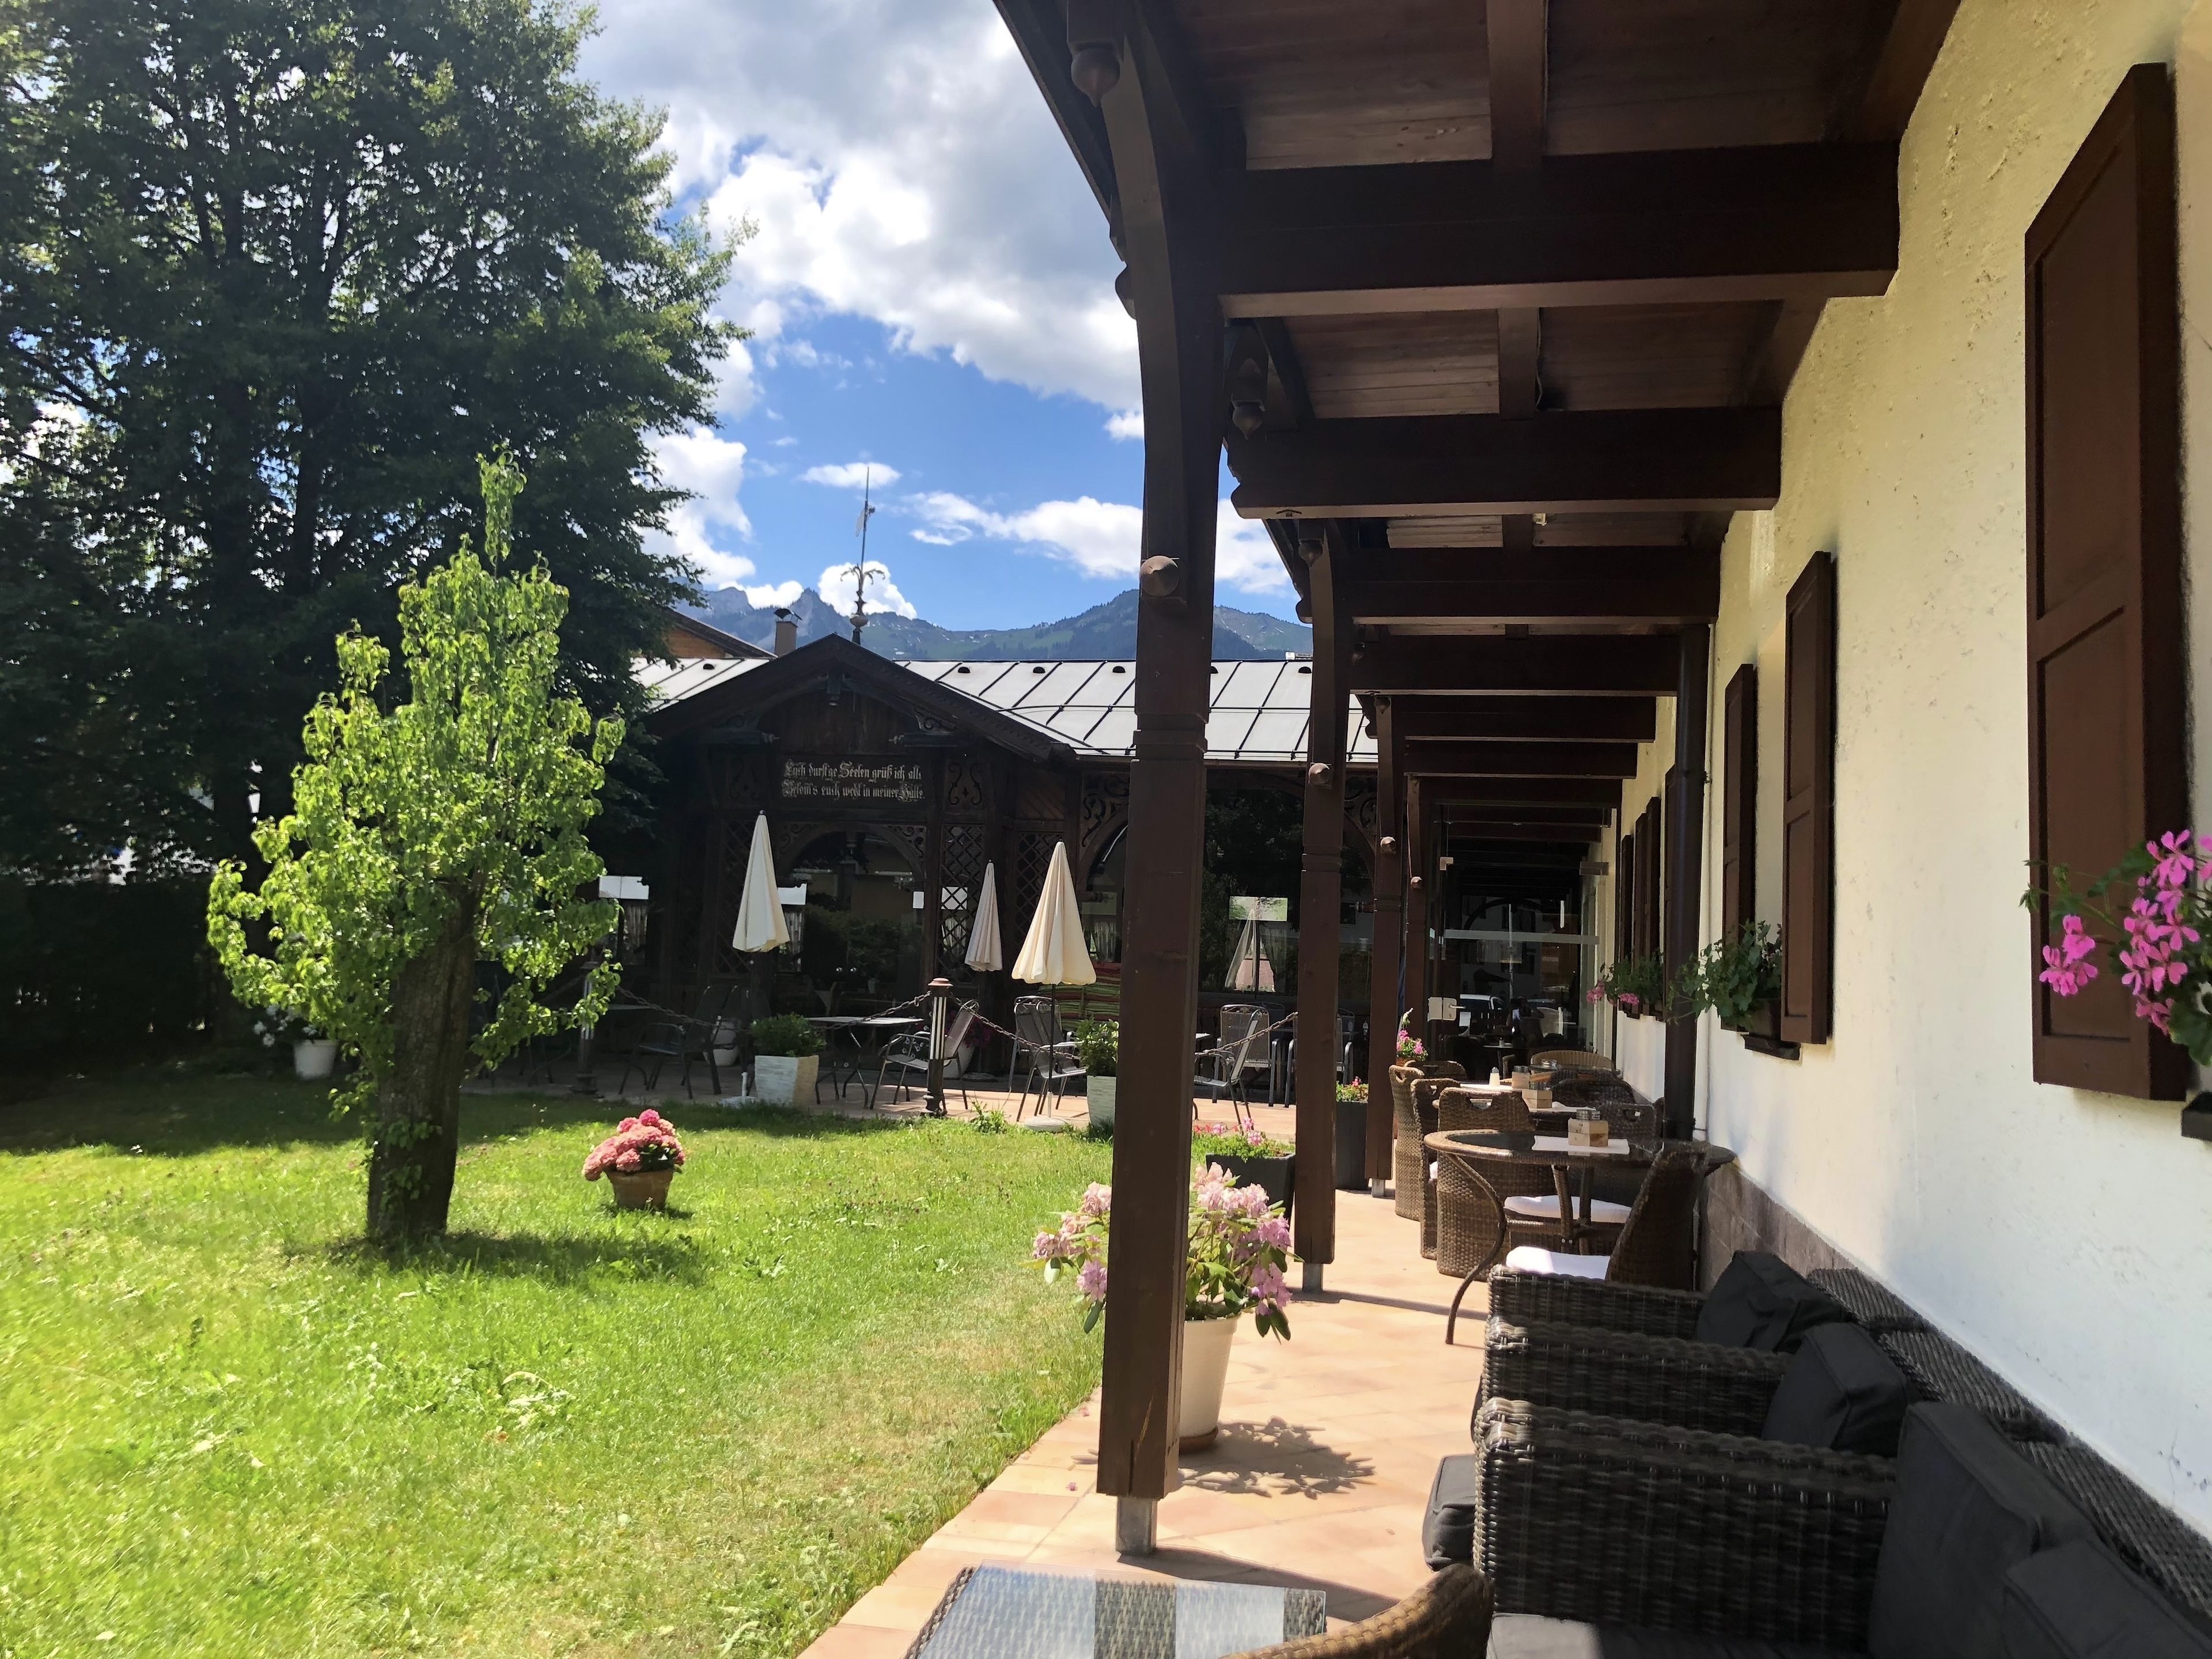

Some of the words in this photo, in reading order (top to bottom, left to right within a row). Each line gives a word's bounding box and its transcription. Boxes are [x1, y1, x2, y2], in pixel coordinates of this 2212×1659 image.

[838, 761, 869, 778] Seelen
[868, 764, 893, 783] grüß
[894, 765, 905, 783] ich
[821, 781, 840, 800] euch
[842, 783, 862, 800] wohl
[862, 784, 870, 797] in
[872, 785, 899, 798] meiner
